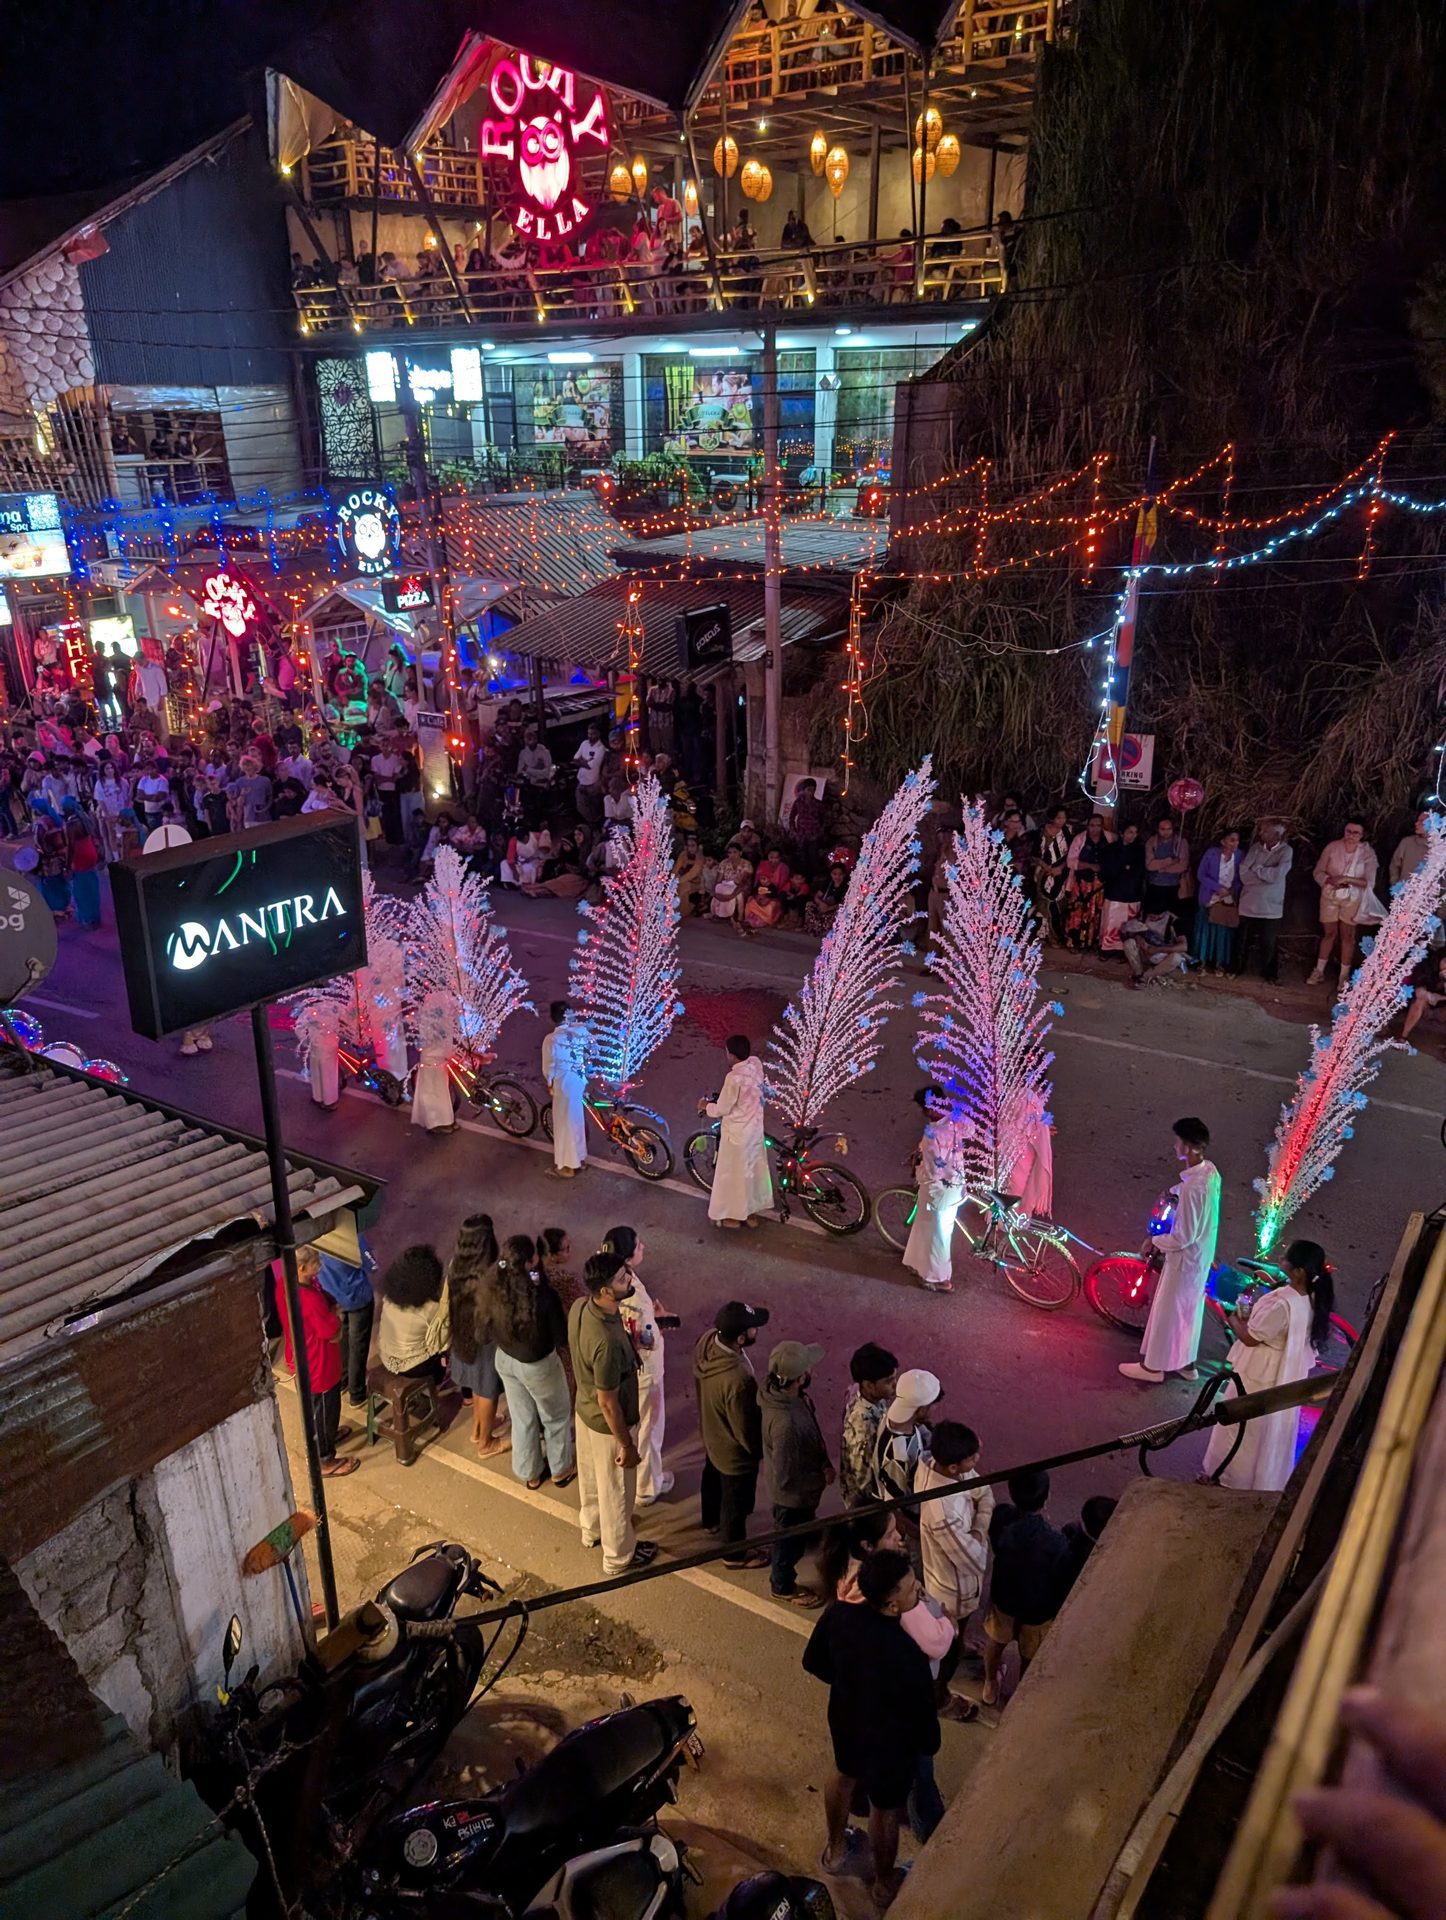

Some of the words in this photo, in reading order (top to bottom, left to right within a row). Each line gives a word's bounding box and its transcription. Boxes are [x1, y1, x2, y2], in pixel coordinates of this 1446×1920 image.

[516, 198, 589, 239] ELLA
[337, 491, 399, 522] ROCKY
[358, 556, 391, 573] ELLA
[396, 590, 430, 608] PIZZA
[167, 887, 347, 970] MANTRA
